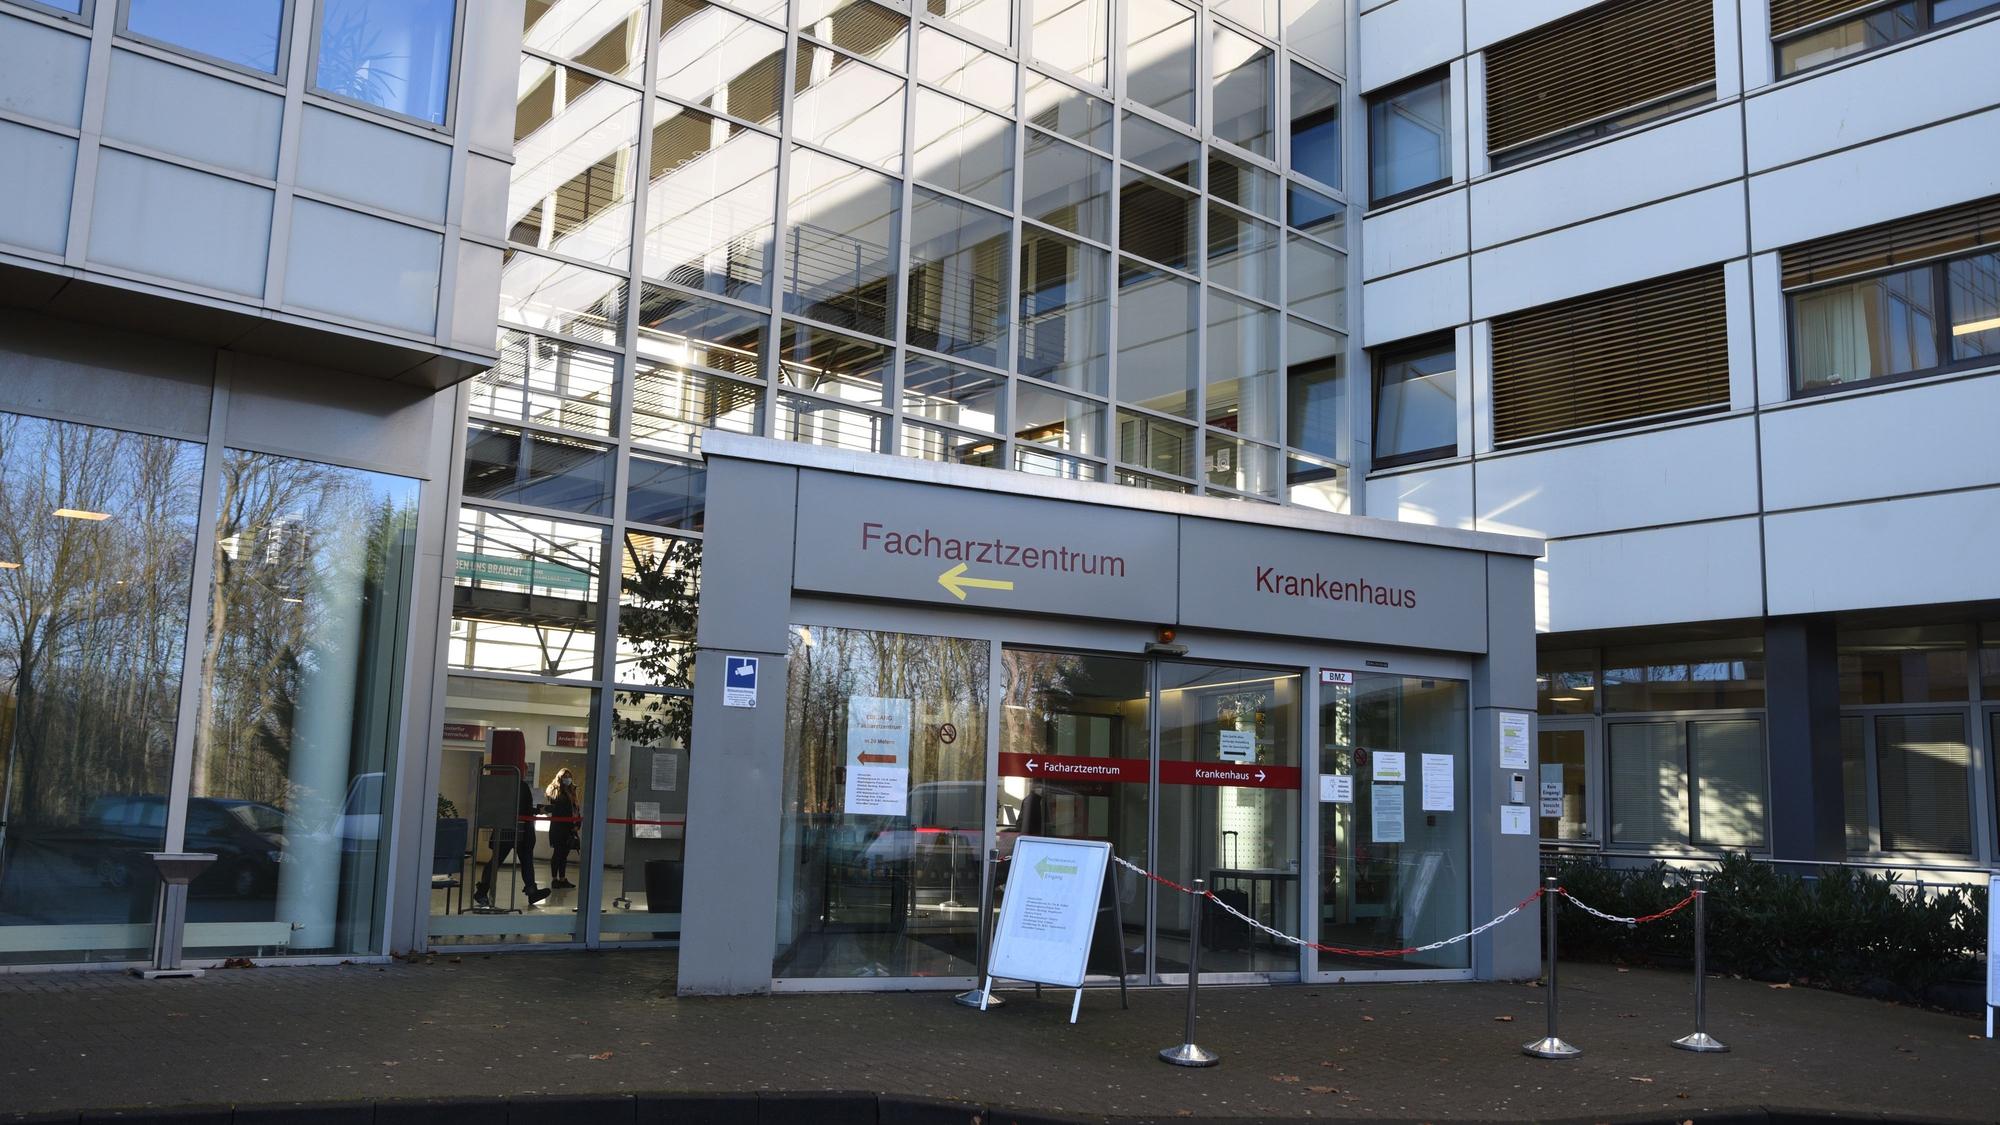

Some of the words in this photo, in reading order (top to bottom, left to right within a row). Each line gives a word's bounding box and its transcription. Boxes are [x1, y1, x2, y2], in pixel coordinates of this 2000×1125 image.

[861, 522, 1126, 577] Facharztzentrum
[1256, 566, 1417, 609] Krankenhaus
[1329, 673, 1346, 681] BMZ
[1044, 762, 1120, 775] Facharztzentrum
[1195, 769, 1250, 780] Krankenhaus
